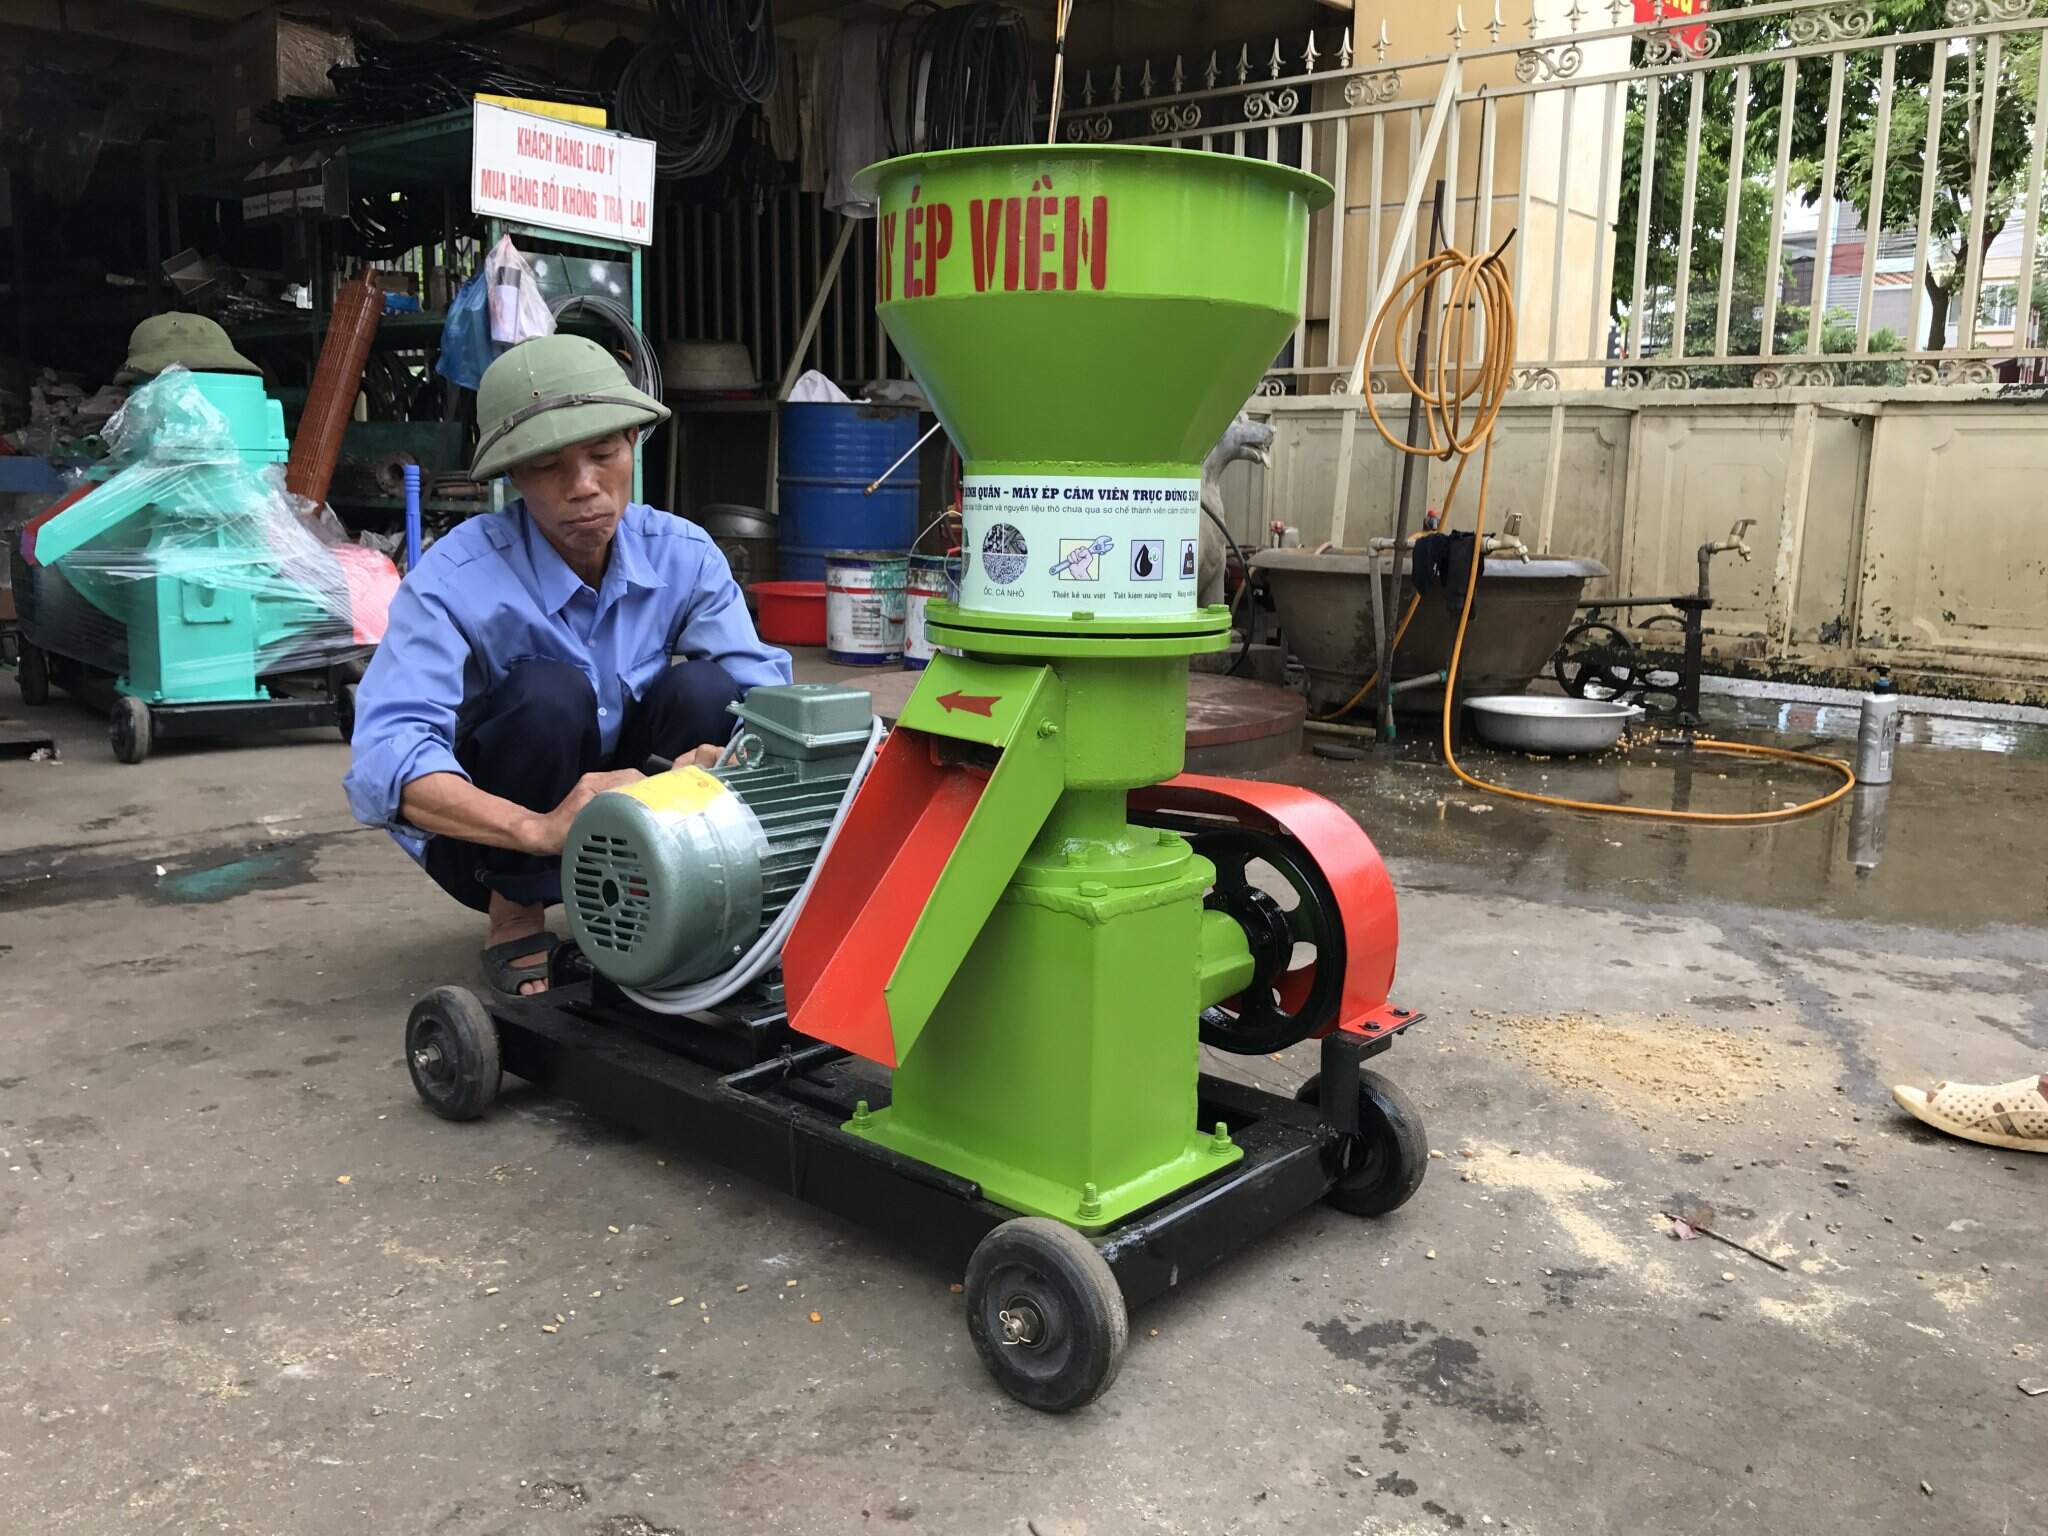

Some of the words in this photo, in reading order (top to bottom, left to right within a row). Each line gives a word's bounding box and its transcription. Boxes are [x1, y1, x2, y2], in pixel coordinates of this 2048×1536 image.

[517, 123, 552, 162] KHÁCH
[555, 131, 584, 169] HÀNG
[608, 142, 615, 176] Ý
[481, 168, 507, 202] MUA
[510, 169, 539, 209] HÀNG
[562, 182, 597, 220] KHÔNG
[630, 199, 646, 234] LẠI
[904, 184, 953, 299] ÉP
[969, 174, 1108, 293] VIÊN
[1012, 484, 1039, 499] MÁY
[1042, 484, 1060, 500] ÉP
[1098, 486, 1129, 501] VIÊN
[1132, 489, 1163, 504] TRỤC
[1085, 507, 1100, 515] qua
